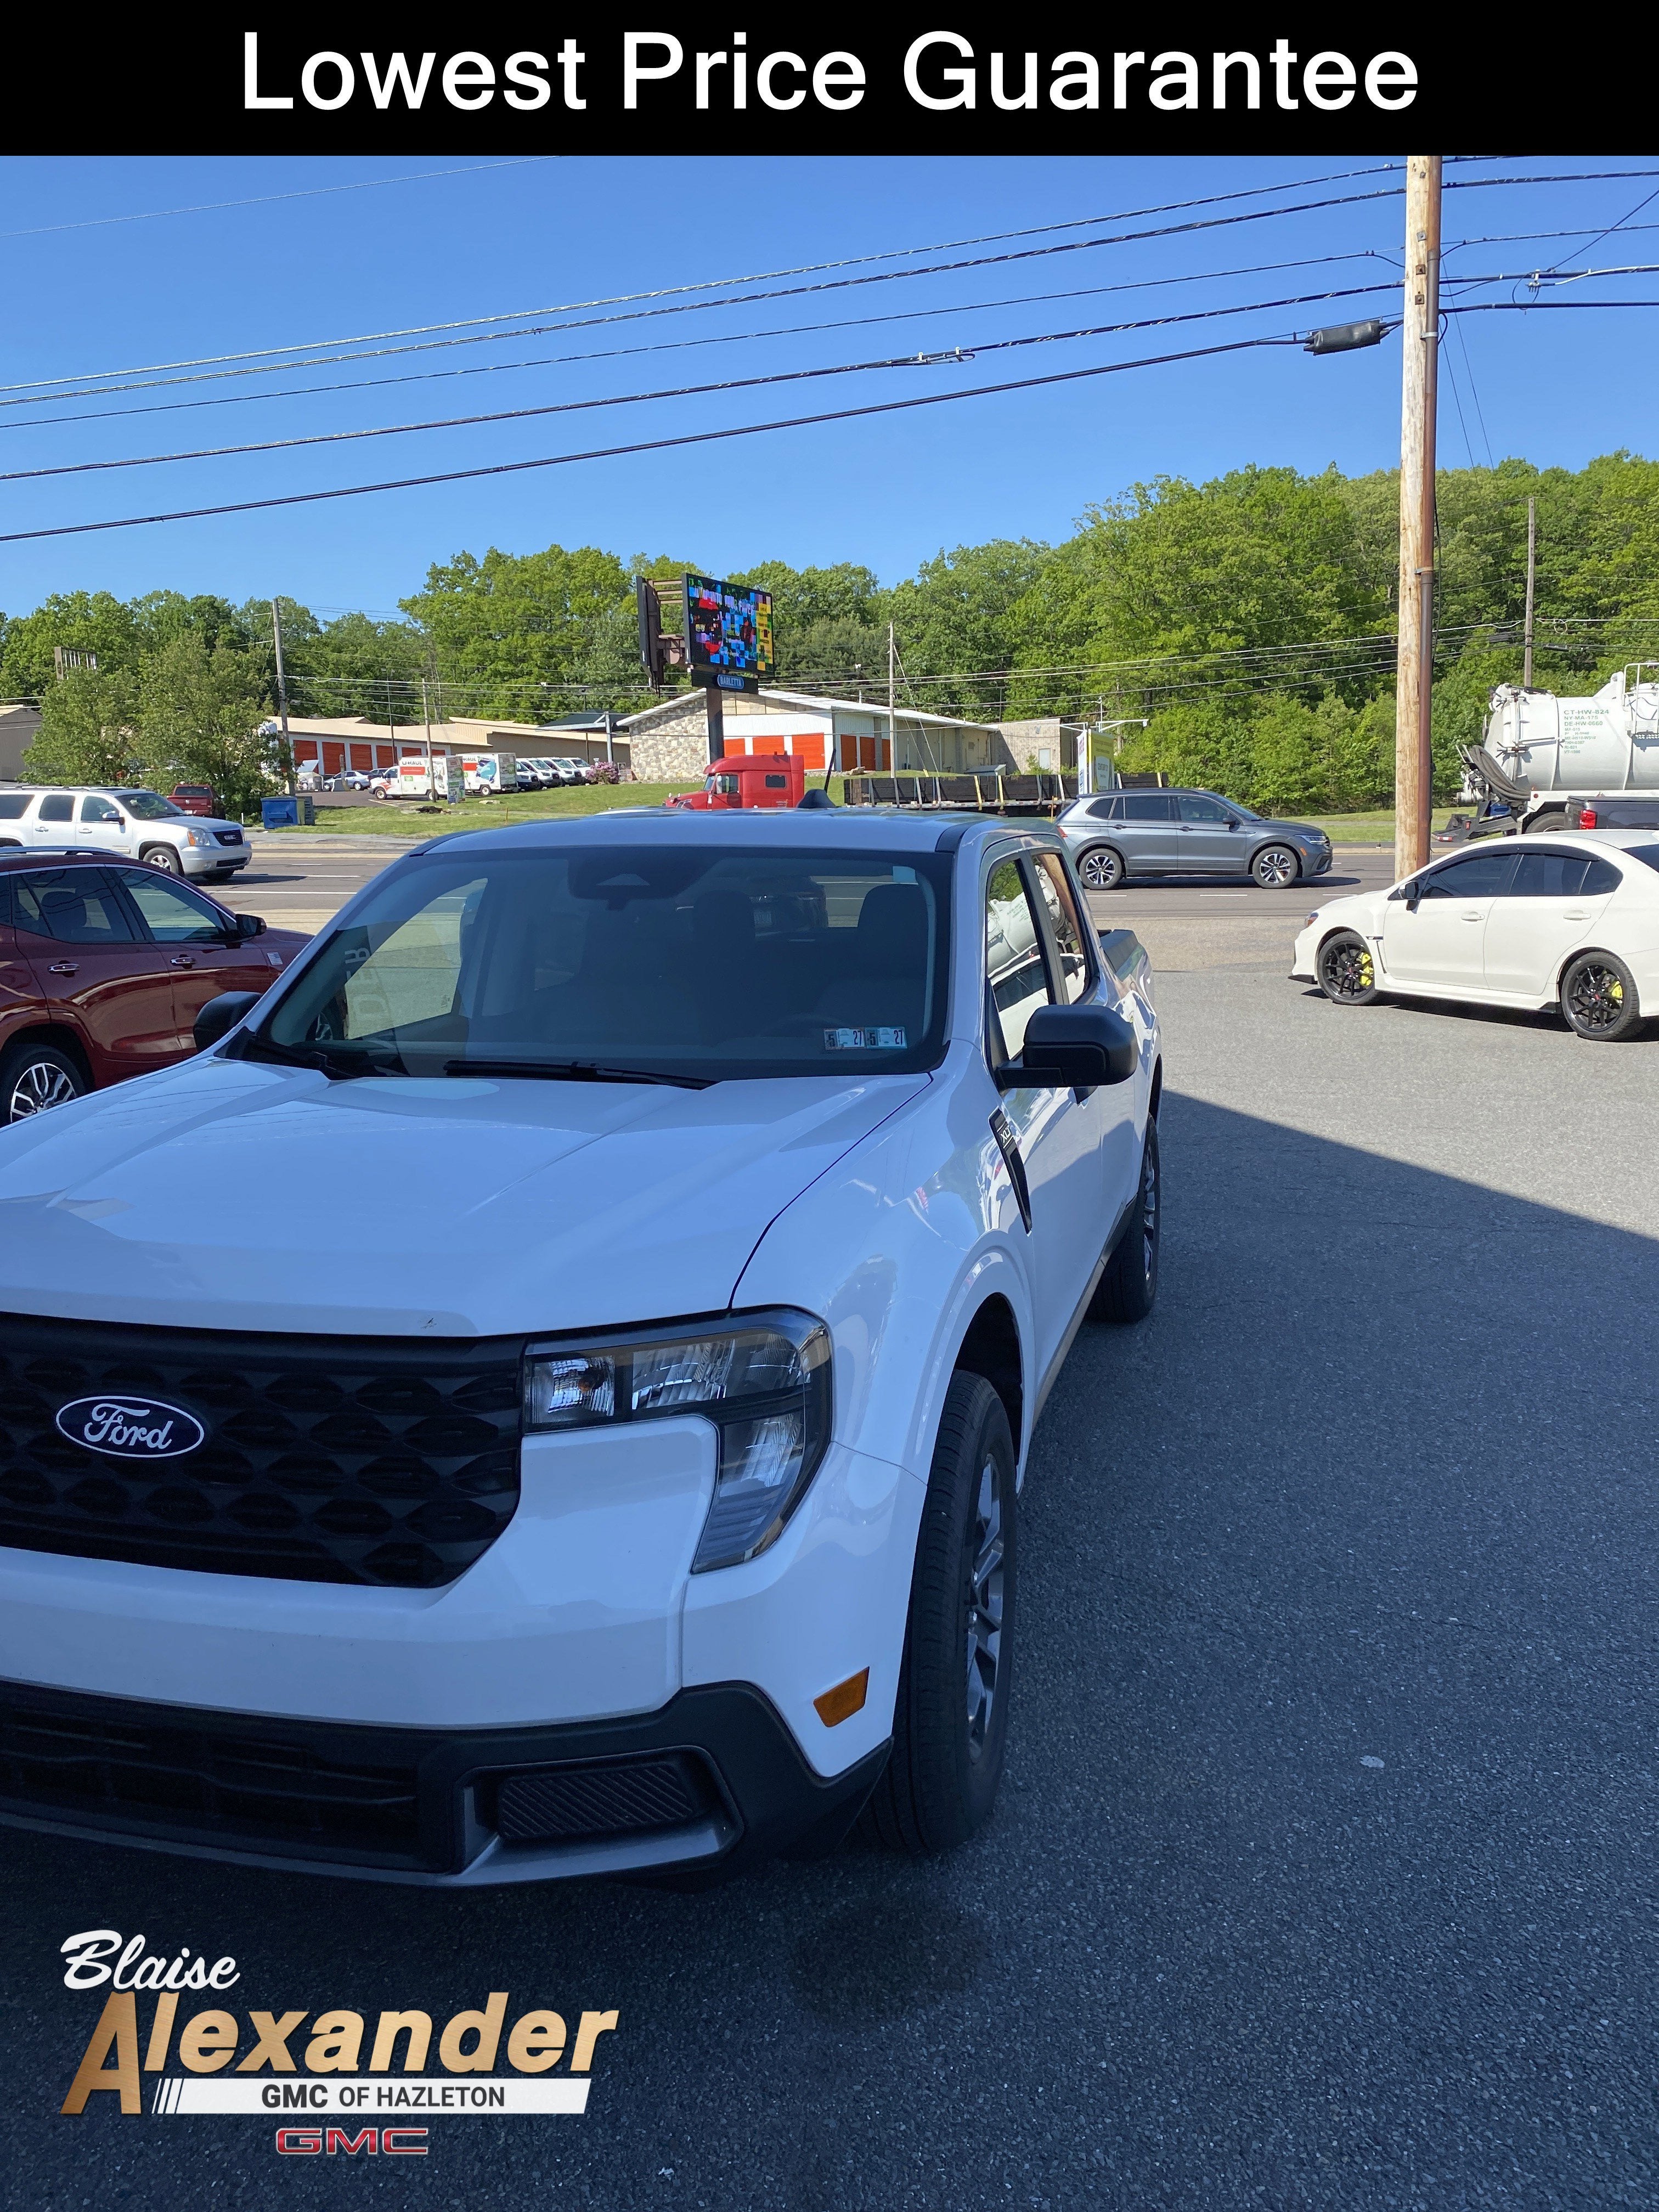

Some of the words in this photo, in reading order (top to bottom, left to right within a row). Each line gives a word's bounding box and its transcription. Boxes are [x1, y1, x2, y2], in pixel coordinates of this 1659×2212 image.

[720, 676, 742, 688] BARLETTA
[828, 1034, 836, 1047] 5
[853, 1030, 862, 1046] 27
[870, 1032, 876, 1046] 5
[894, 1030, 903, 1046] 27
[1000, 1125, 1011, 1143] XLT
[84, 1403, 173, 1449] Ford
